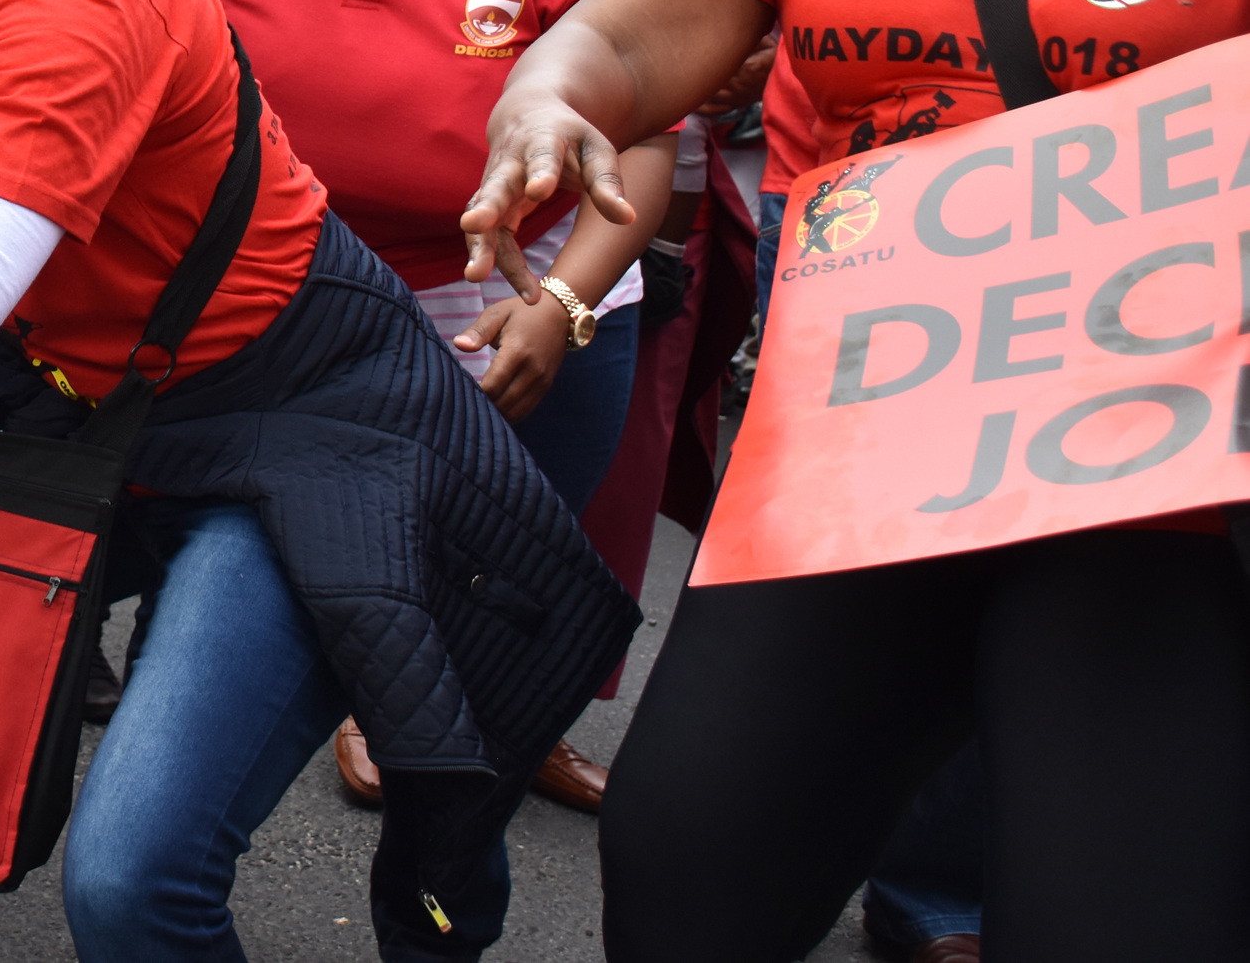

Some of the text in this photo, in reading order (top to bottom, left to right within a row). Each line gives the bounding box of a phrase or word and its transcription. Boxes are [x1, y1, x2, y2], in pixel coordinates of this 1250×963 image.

[454, 44, 514, 58] DENOSA
[1042, 35, 1141, 79] 018
[914, 83, 1250, 258] CRE
[781, 246, 895, 282] COSATU
